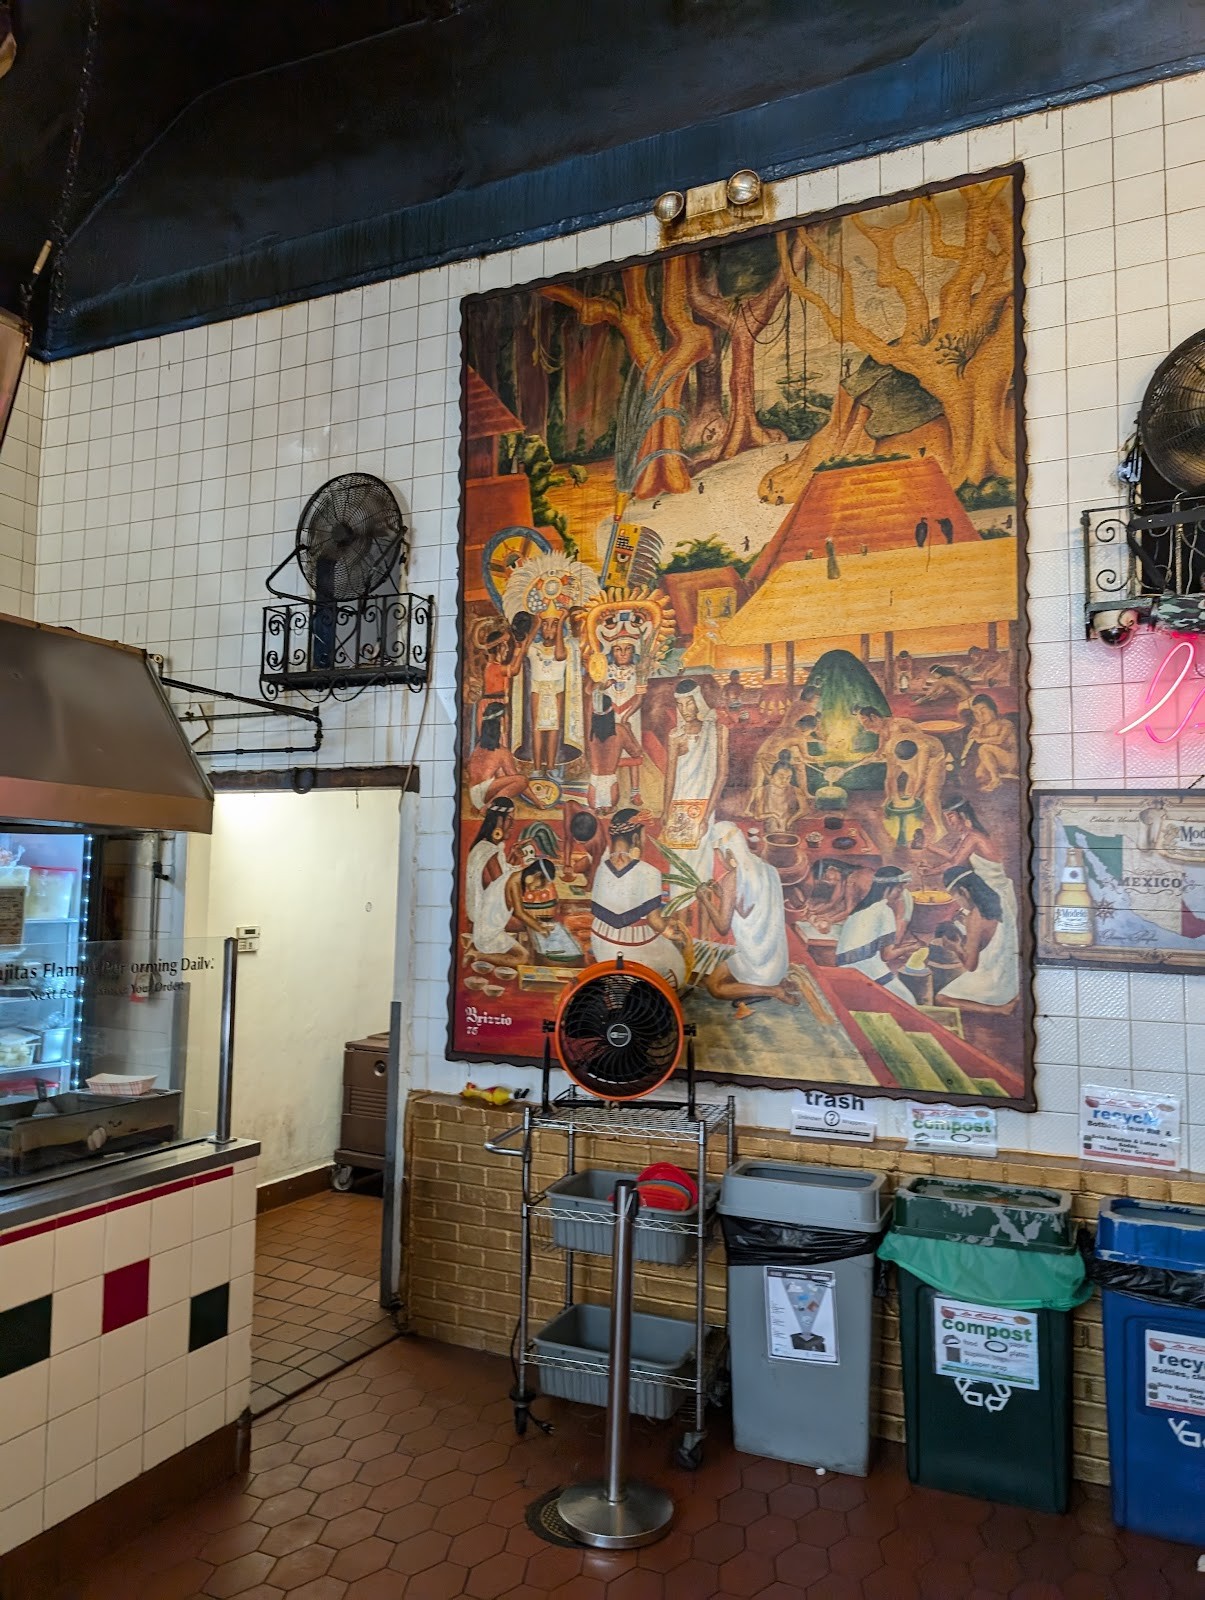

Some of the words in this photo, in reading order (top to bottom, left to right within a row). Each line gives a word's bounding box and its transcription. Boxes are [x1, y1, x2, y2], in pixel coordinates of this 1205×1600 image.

[1117, 876, 1183, 889] MEXICO
[465, 1006, 512, 1026] Brizzio
[804, 1091, 865, 1111] trash
[912, 1120, 992, 1133] compost
[942, 1319, 1032, 1343] compost
